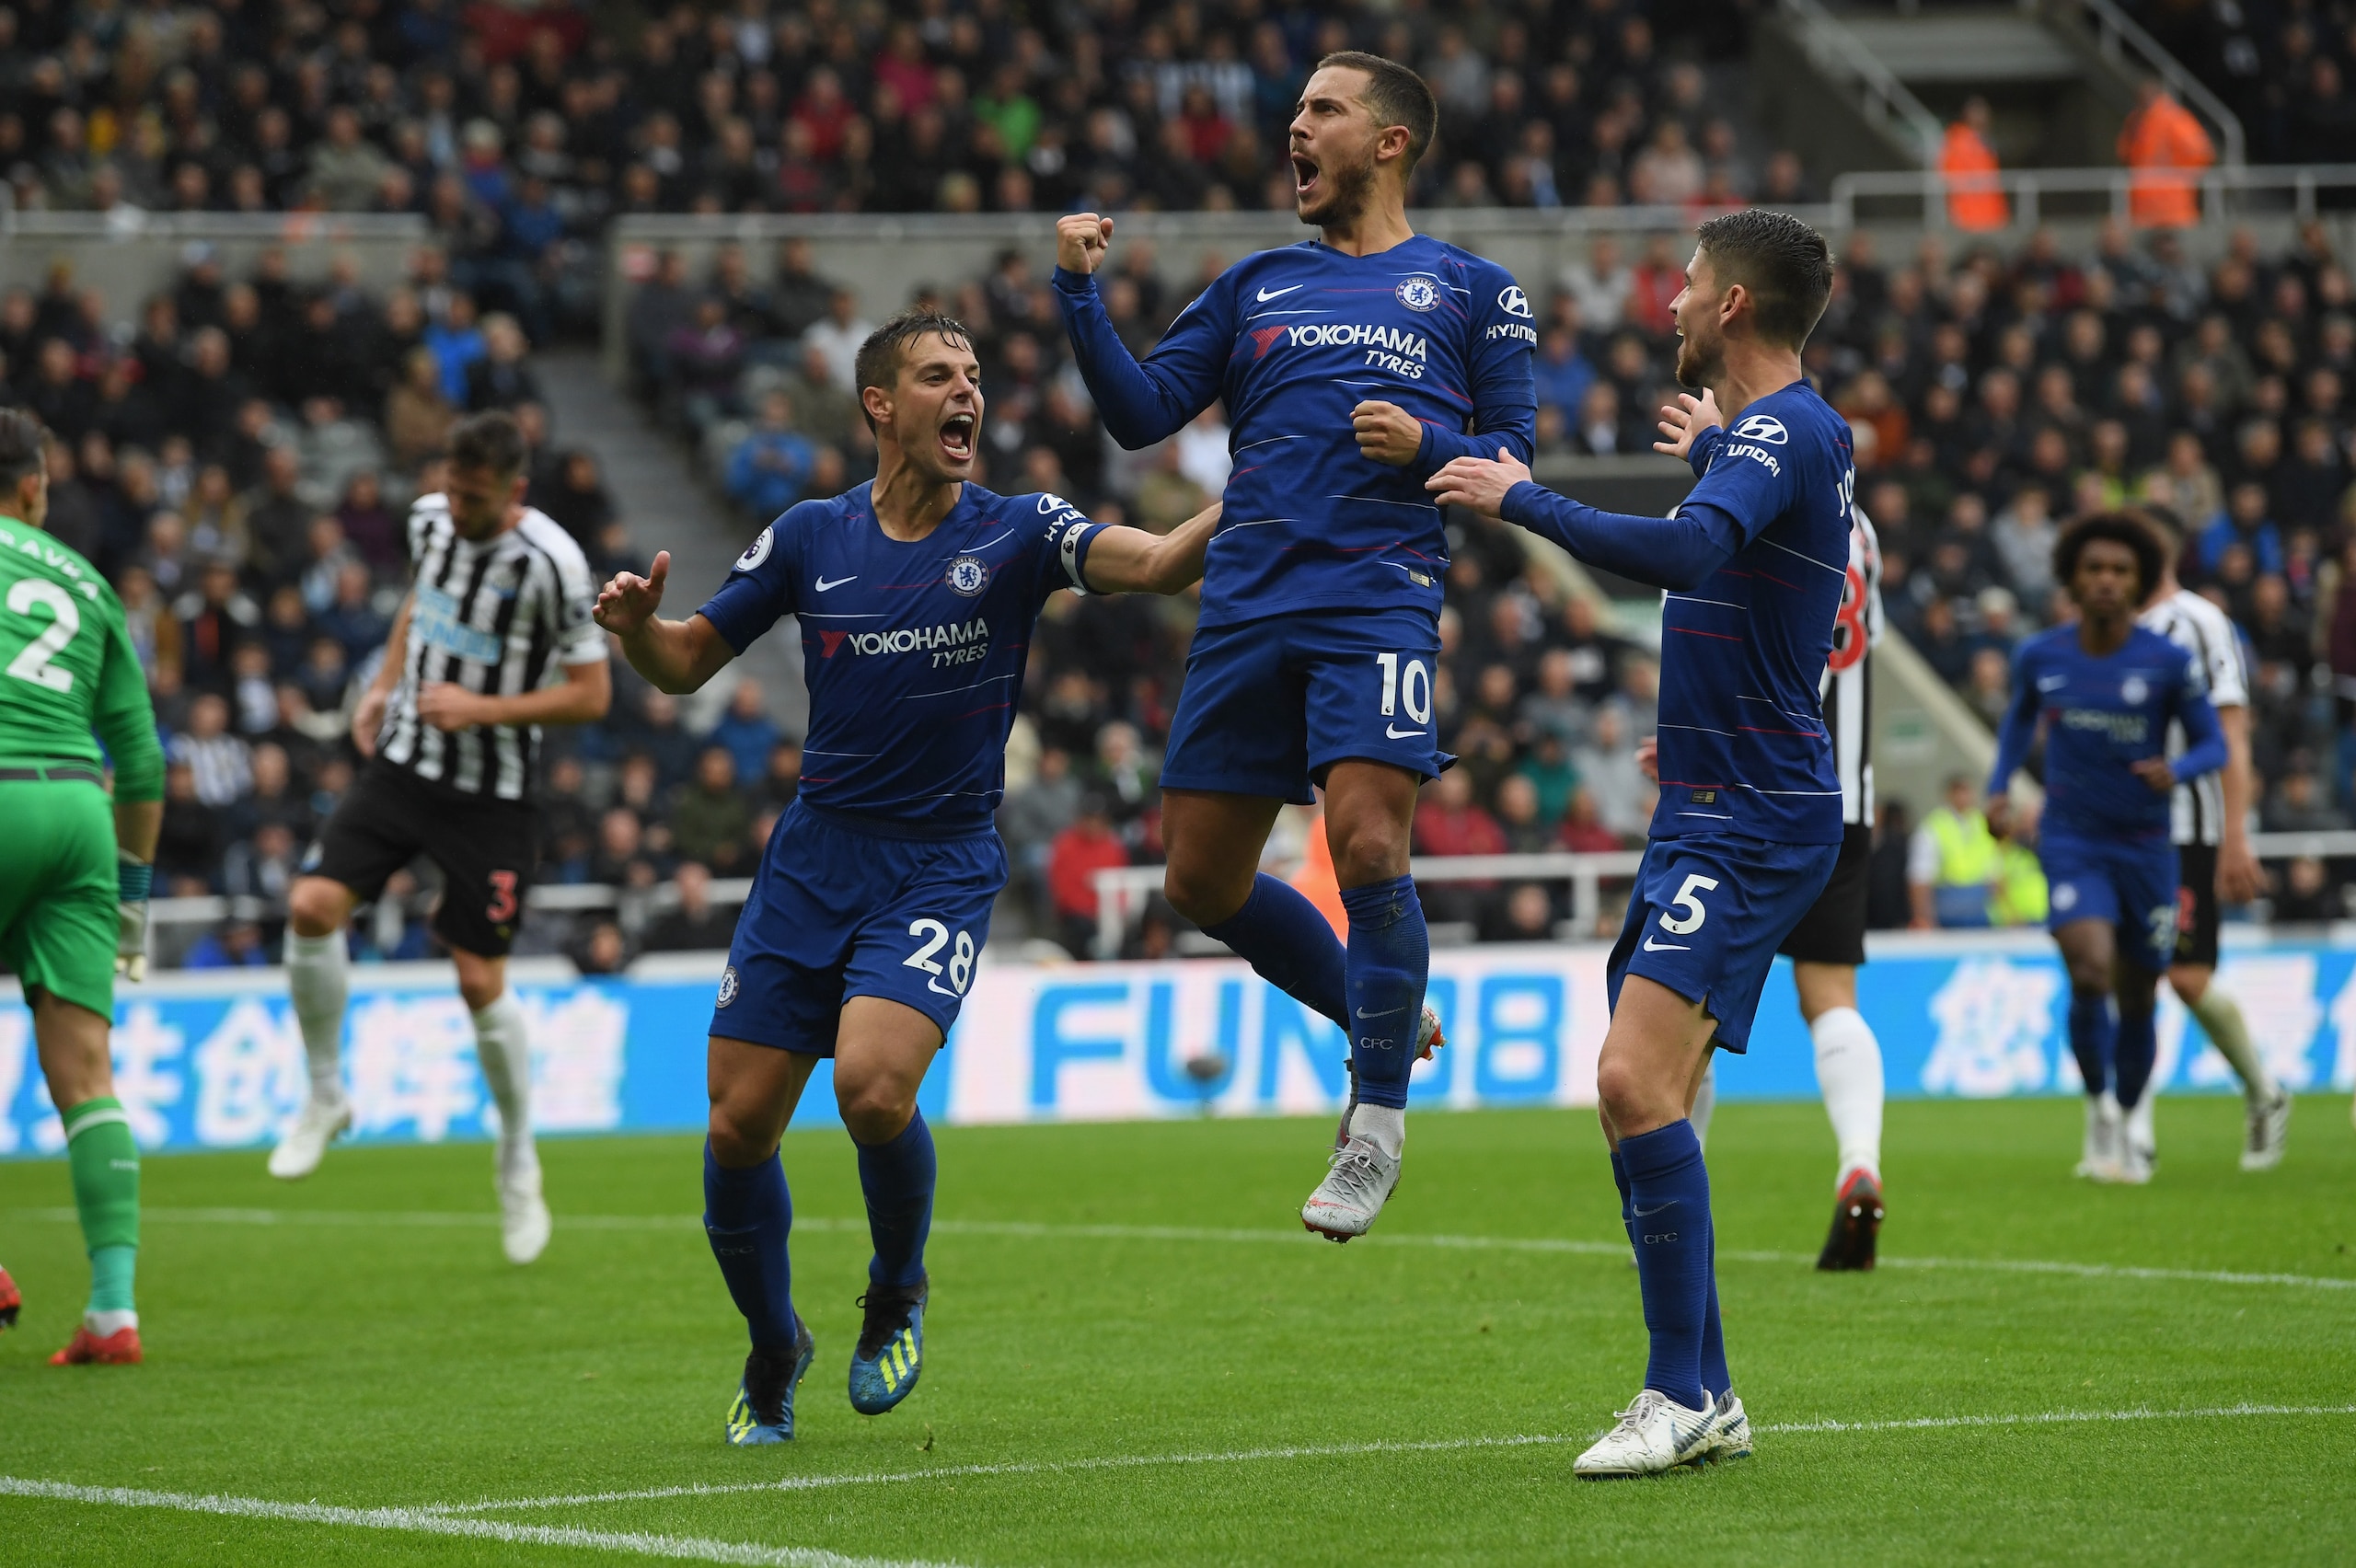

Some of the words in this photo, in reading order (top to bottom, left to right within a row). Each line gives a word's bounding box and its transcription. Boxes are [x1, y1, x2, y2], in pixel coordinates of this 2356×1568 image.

[1288, 325, 1426, 362] YOKOHAMA
[1365, 350, 1425, 379] TYRES
[952, 558, 980, 568] CHELSEA
[6, 578, 80, 694] 2
[848, 617, 988, 656] YOKOHAMA
[931, 643, 988, 669] TYRES
[1376, 652, 1430, 725] 10
[487, 870, 518, 923] 3
[1658, 873, 1719, 935] 5
[902, 918, 975, 994] 28
[1360, 1036, 1394, 1050] CFC
[1644, 1232, 1678, 1245] CFC
